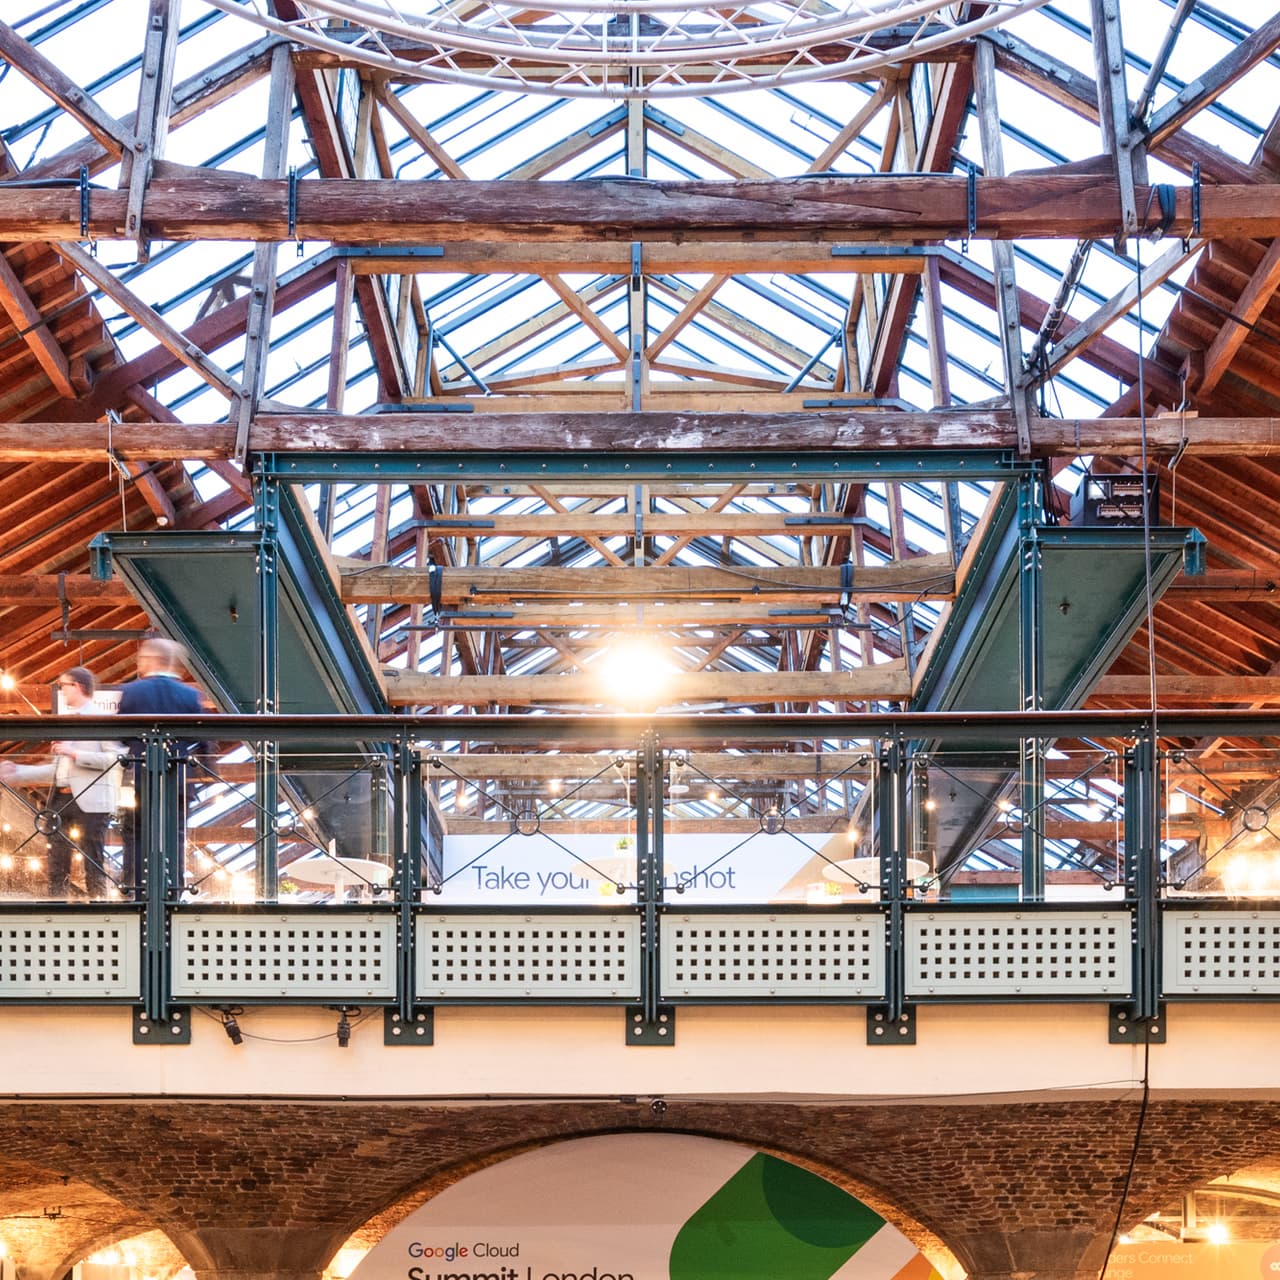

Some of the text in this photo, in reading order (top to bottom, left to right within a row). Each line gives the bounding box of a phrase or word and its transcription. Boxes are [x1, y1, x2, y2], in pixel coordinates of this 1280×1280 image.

[471, 865, 531, 890] Take
[408, 1242, 520, 1261] Google Cloud
[1138, 1251, 1194, 1264] Connect
